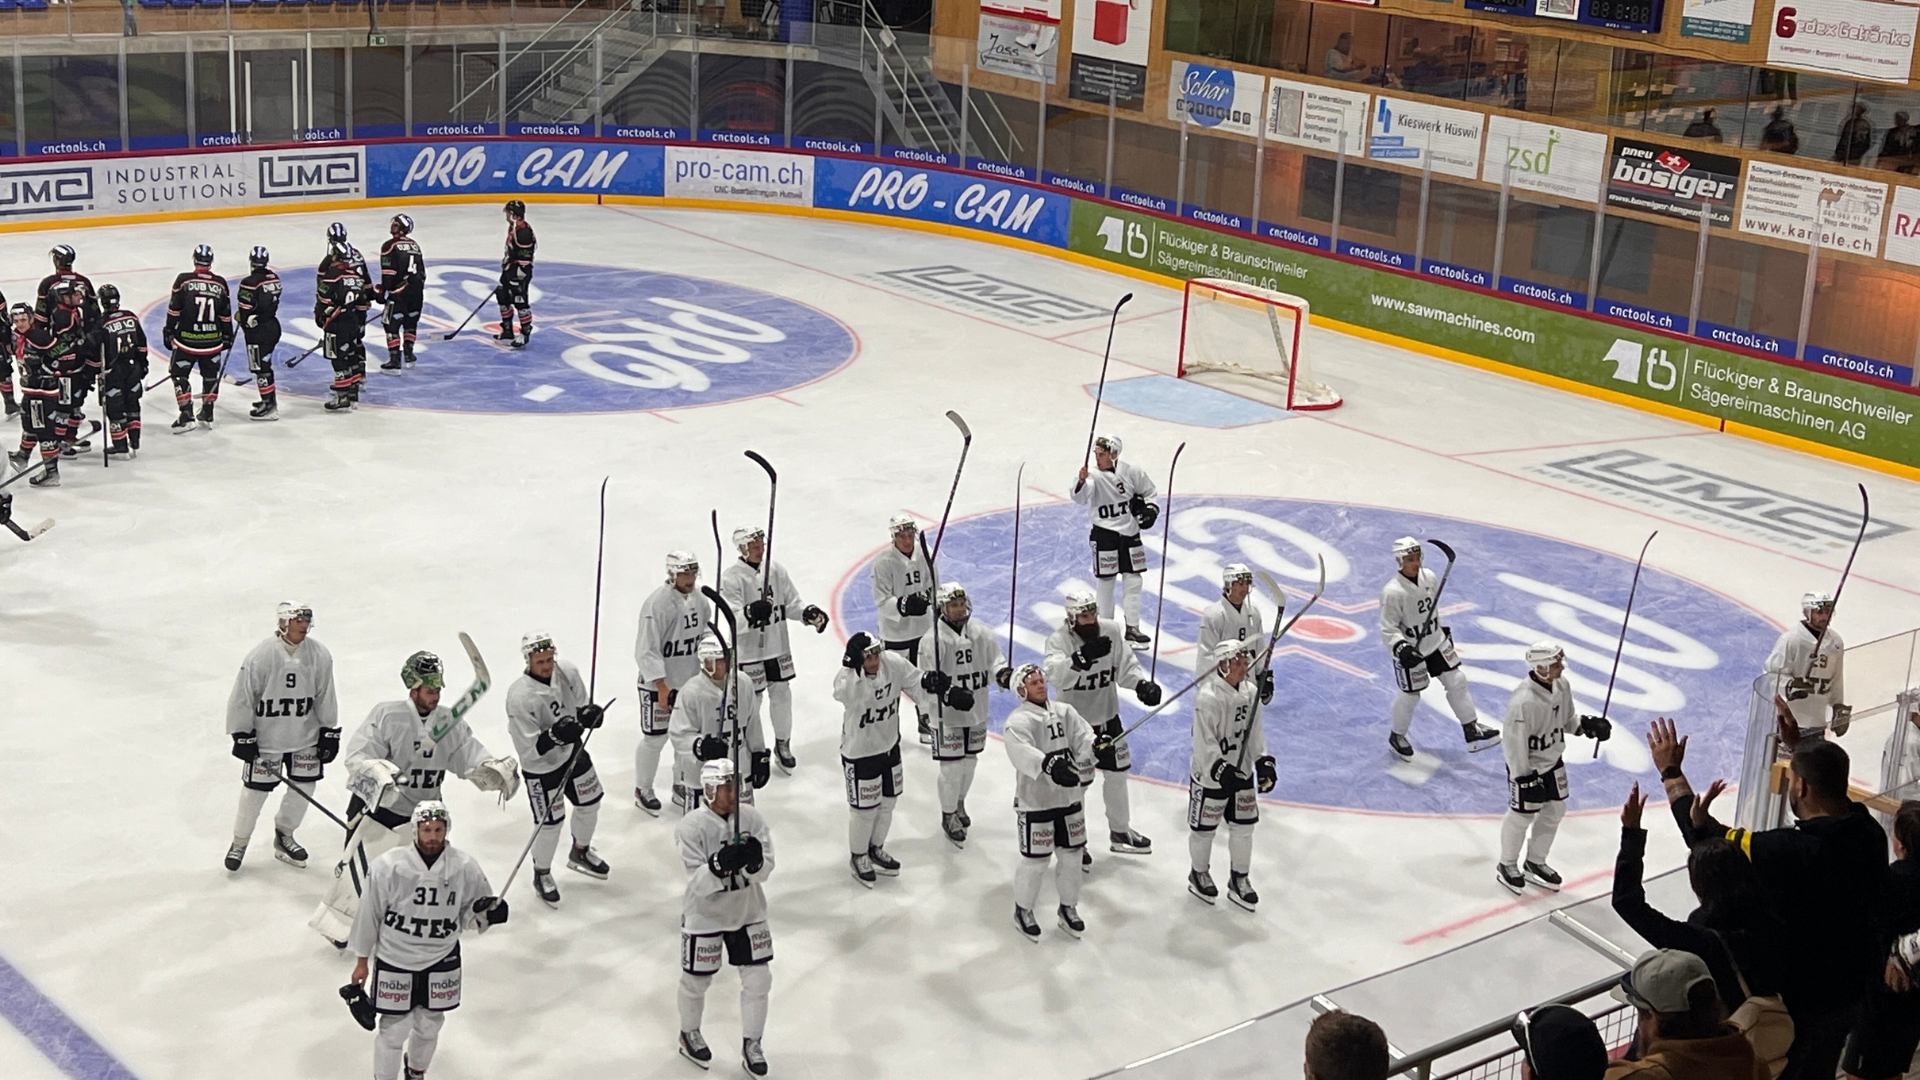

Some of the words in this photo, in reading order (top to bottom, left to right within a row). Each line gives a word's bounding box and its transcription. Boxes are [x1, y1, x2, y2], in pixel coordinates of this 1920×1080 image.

[1837, 20, 1911, 47] Getränke
[1178, 70, 1230, 102] Schär
[426, 124, 485, 136] cnctools.ch
[520, 125, 580, 137] cnctools.ch
[1397, 113, 1441, 133] Kieswerk
[616, 127, 676, 140] cnctools.ch
[712, 132, 770, 145] cnctools.ch
[41, 140, 106, 154] cnctools.ch
[805, 139, 861, 154] cnctools.ch
[894, 148, 947, 164] cnctools.ch
[1621, 146, 1654, 160] pneu
[107, 163, 235, 185] INDUSTRIAL
[402, 145, 487, 191] PRO
[516, 148, 629, 189] CAM
[675, 159, 804, 185] pro-cam.ch
[977, 160, 1025, 178] cnctools.ch
[1052, 175, 1095, 194] cnctools.ch
[1612, 157, 1735, 200] bösiger
[118, 182, 247, 204] SOLUTIONS
[848, 166, 928, 211] PRO
[954, 183, 1045, 234] CAM
[1121, 193, 1165, 210] cnctools.ch
[1193, 209, 1240, 229] cnctools.ch
[1269, 227, 1319, 247] cnctools.ch
[1745, 219, 1873, 252] www.kaele.ch
[407, 255, 417, 274] 4
[1159, 231, 1208, 256] Flückiger
[1210, 243, 1218, 257] &
[1221, 245, 1308, 280] Braunschweiler
[1349, 243, 1402, 266] cnctools.ch
[1157, 250, 1257, 285] Sägereimaschinen
[1259, 276, 1278, 291] AG
[1428, 262, 1485, 285] cnctools.ch
[1513, 284, 1572, 305] cnctools.ch
[194, 296, 215, 322] 71
[1371, 293, 1536, 344] www.sawmachines.com
[1609, 304, 1673, 328] cnctools.ch
[1712, 327, 1779, 353] cnctools.ch
[1822, 353, 1894, 379] cnctools.ch
[1693, 358, 1765, 391] Flückiger
[1768, 377, 1780, 395] &
[1784, 380, 1913, 426] Braunschweiler
[1689, 382, 1835, 434] Sägereimaschinen
[1838, 418, 1867, 441] AG
[1116, 482, 1126, 494] 3
[1098, 500, 1129, 519] OLT
[684, 612, 699, 630] 15
[1239, 627, 1246, 641] 8
[955, 649, 973, 665] 26
[286, 673, 296, 688] 9
[413, 887, 439, 906] 31
[446, 891, 456, 906] A
[697, 944, 722, 954] möbe
[379, 979, 411, 990] möbel
[378, 989, 410, 1003] berger
